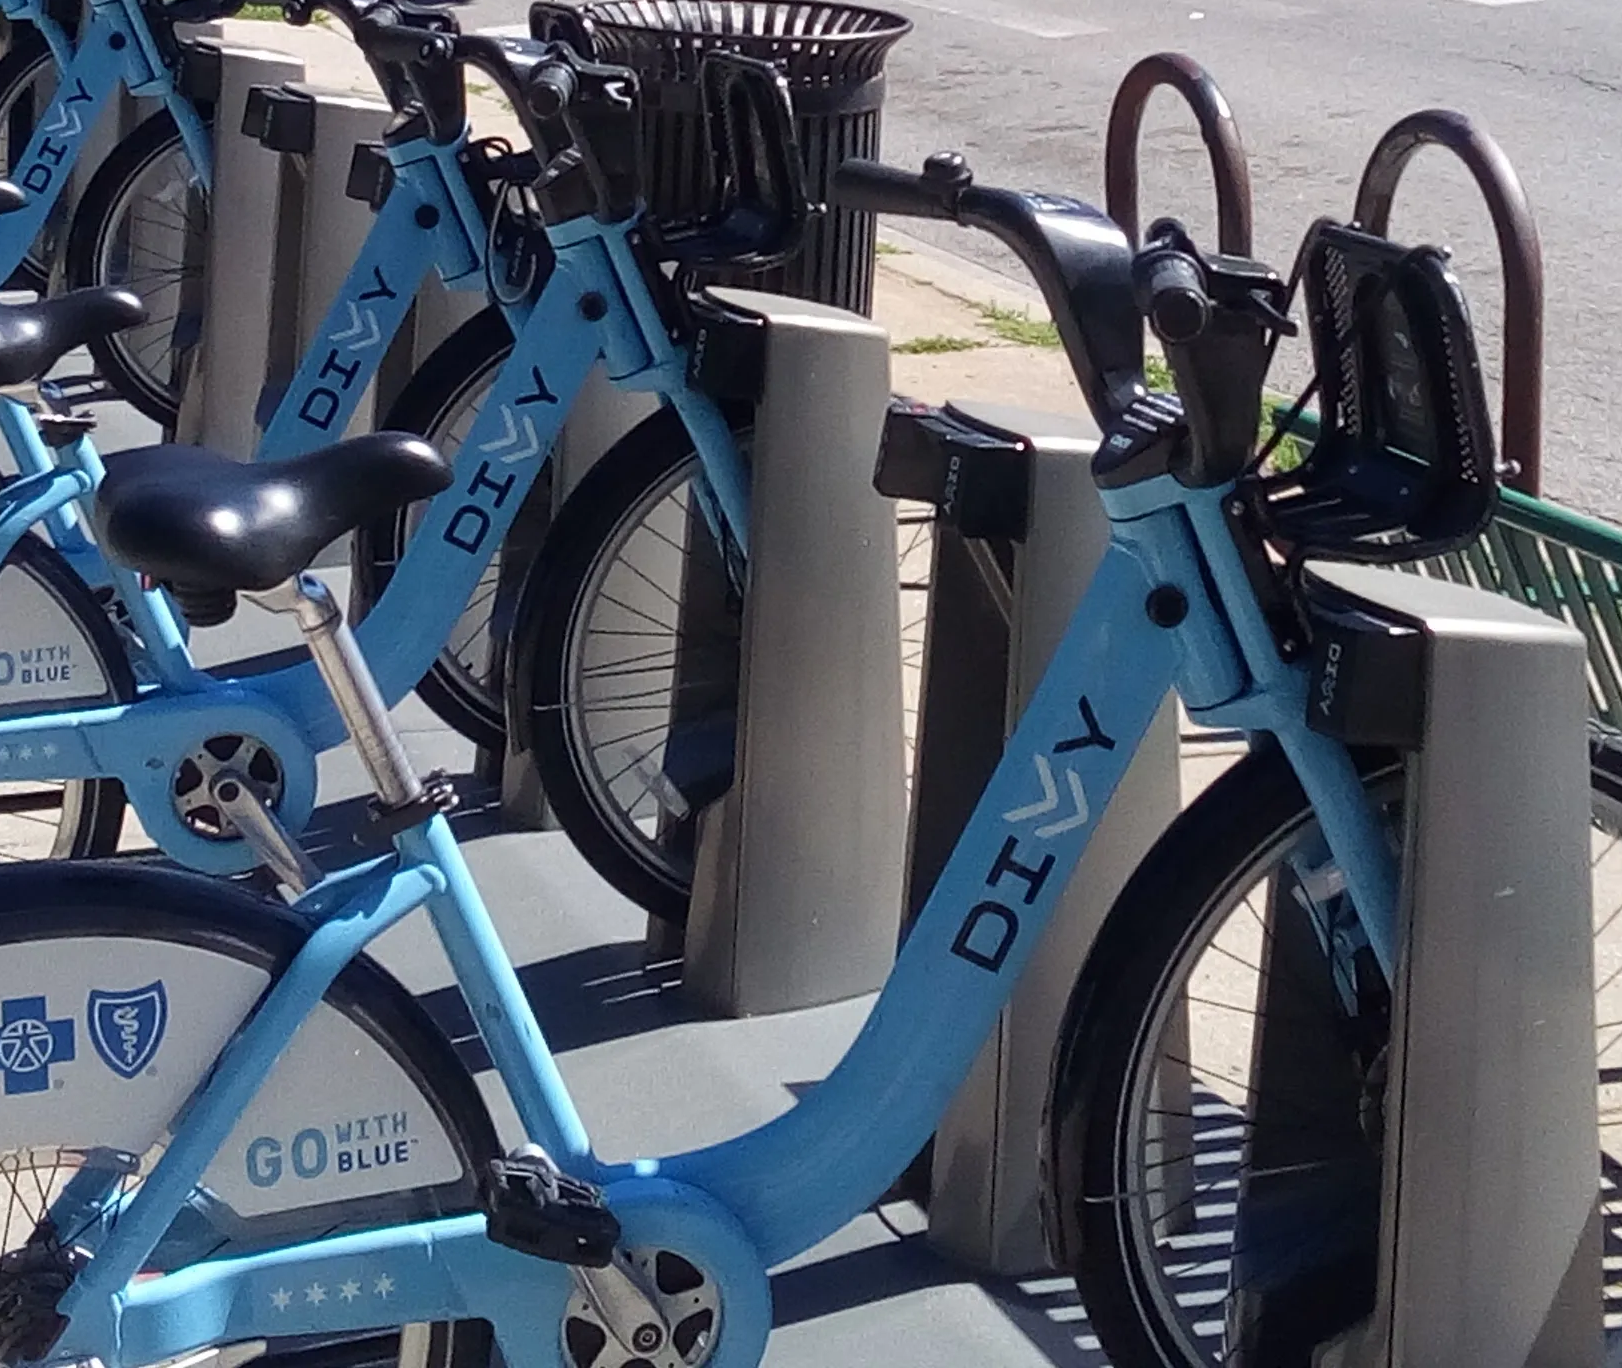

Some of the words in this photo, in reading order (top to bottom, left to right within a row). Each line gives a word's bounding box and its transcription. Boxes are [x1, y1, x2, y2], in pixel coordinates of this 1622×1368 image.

[19, 644, 71, 664] WITH
[21, 664, 72, 684] BLUE
[244, 1126, 329, 1189] GO
[335, 1110, 409, 1144] WITH
[337, 1141, 410, 1174] BLUE
